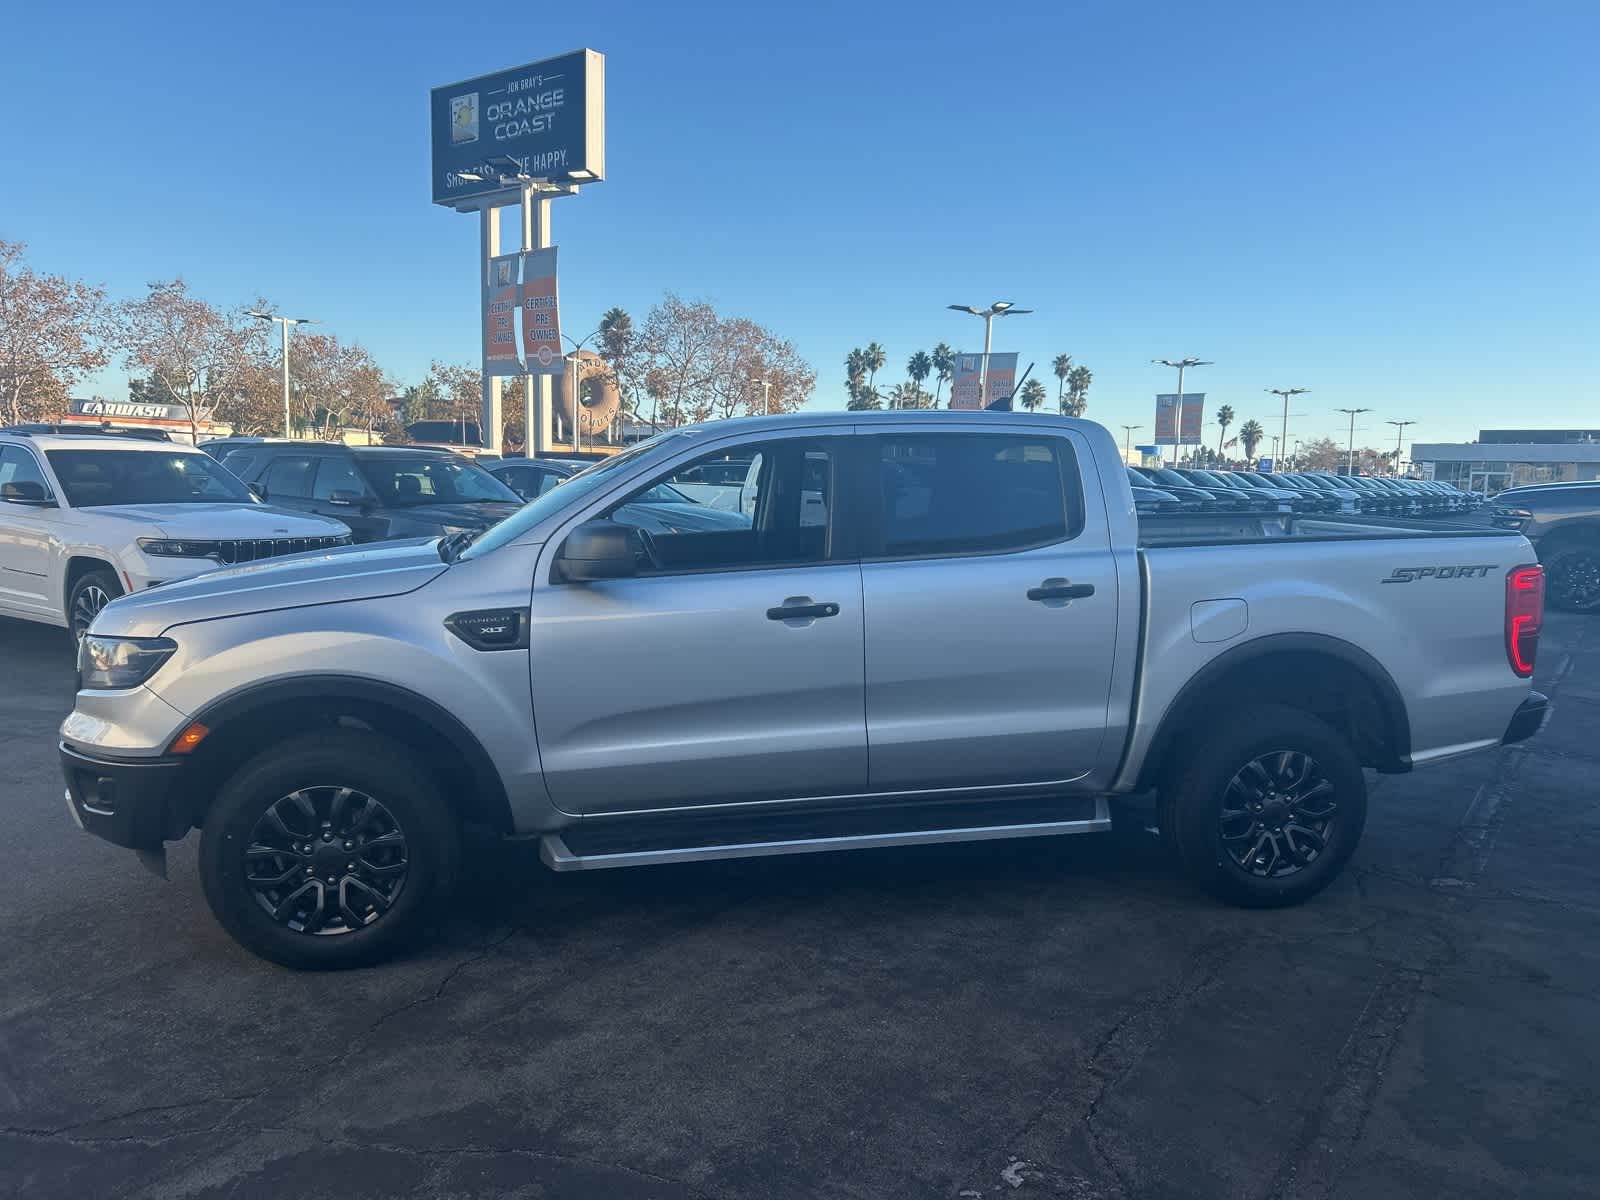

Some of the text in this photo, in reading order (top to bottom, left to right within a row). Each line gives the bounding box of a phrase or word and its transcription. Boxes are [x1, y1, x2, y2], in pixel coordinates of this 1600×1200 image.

[506, 81, 519, 94] JON
[486, 89, 564, 121] ORANGE
[494, 112, 556, 140] COAST
[529, 328, 557, 341] OWNED
[579, 407, 615, 427] ONUTS
[1380, 565, 1499, 584] SPORT
[480, 626, 507, 634] XLT
